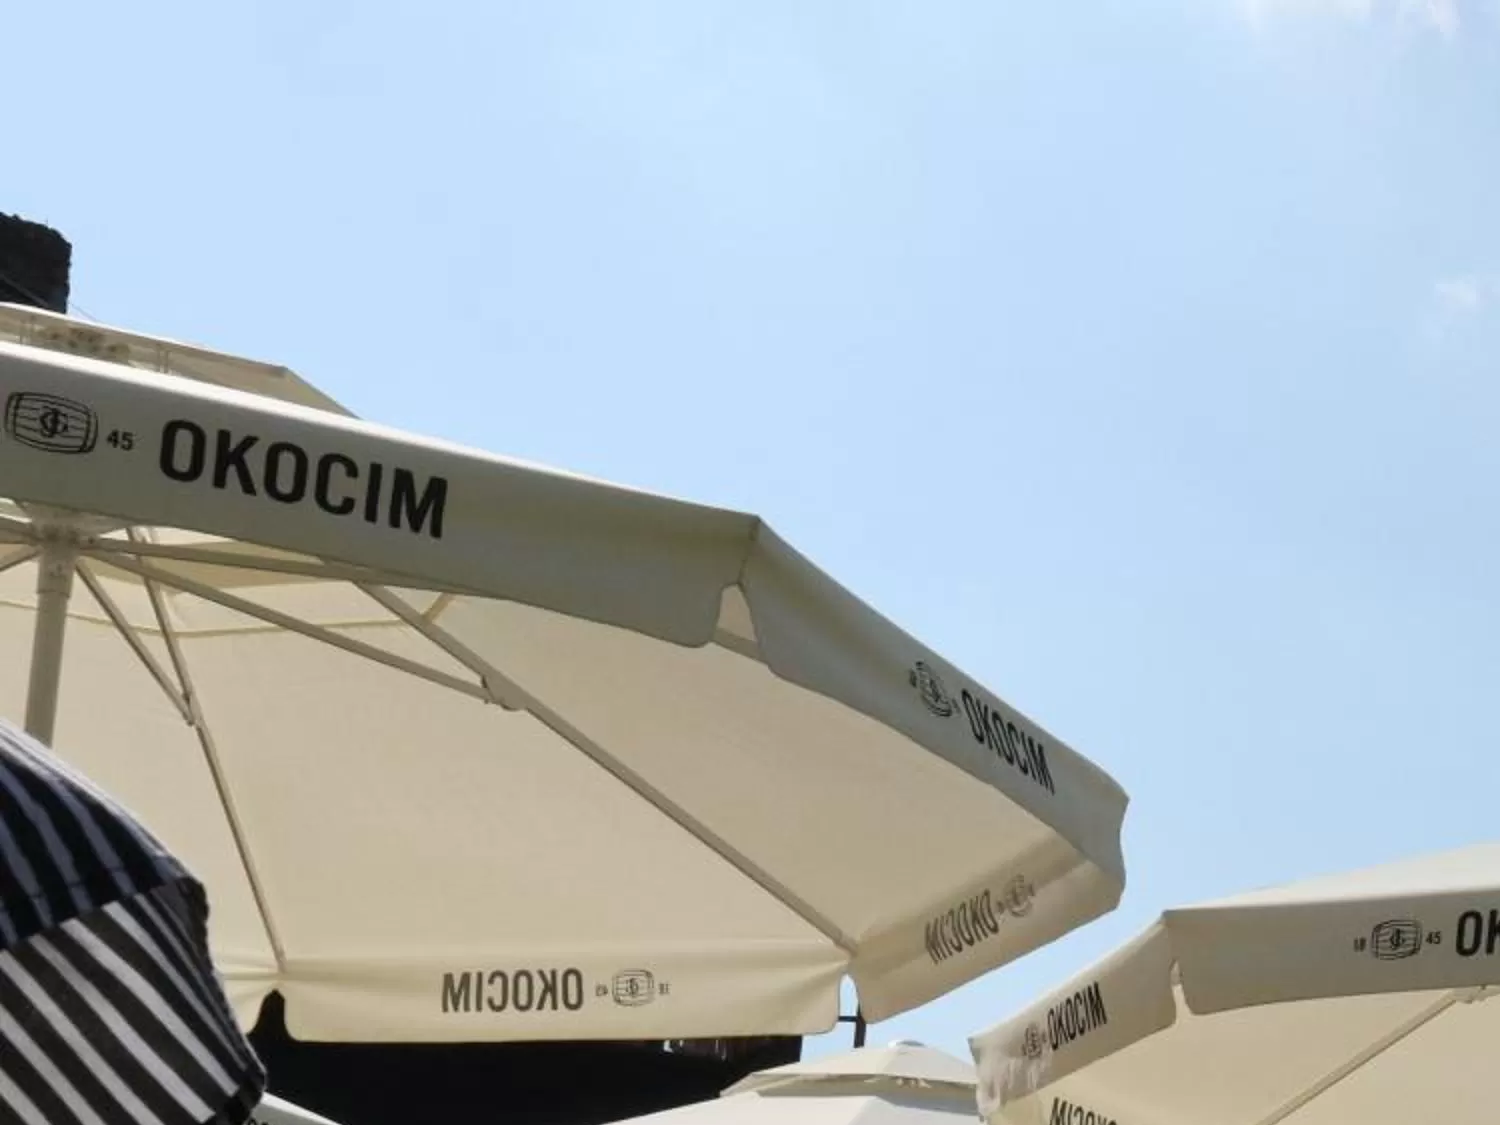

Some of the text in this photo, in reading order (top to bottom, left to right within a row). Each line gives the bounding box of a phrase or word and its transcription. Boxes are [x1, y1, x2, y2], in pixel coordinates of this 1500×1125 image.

[106, 419, 449, 539] 45 OKOCIM
[961, 688, 1055, 796] OKOCIM
[1047, 980, 1108, 1051] OKOCIM
